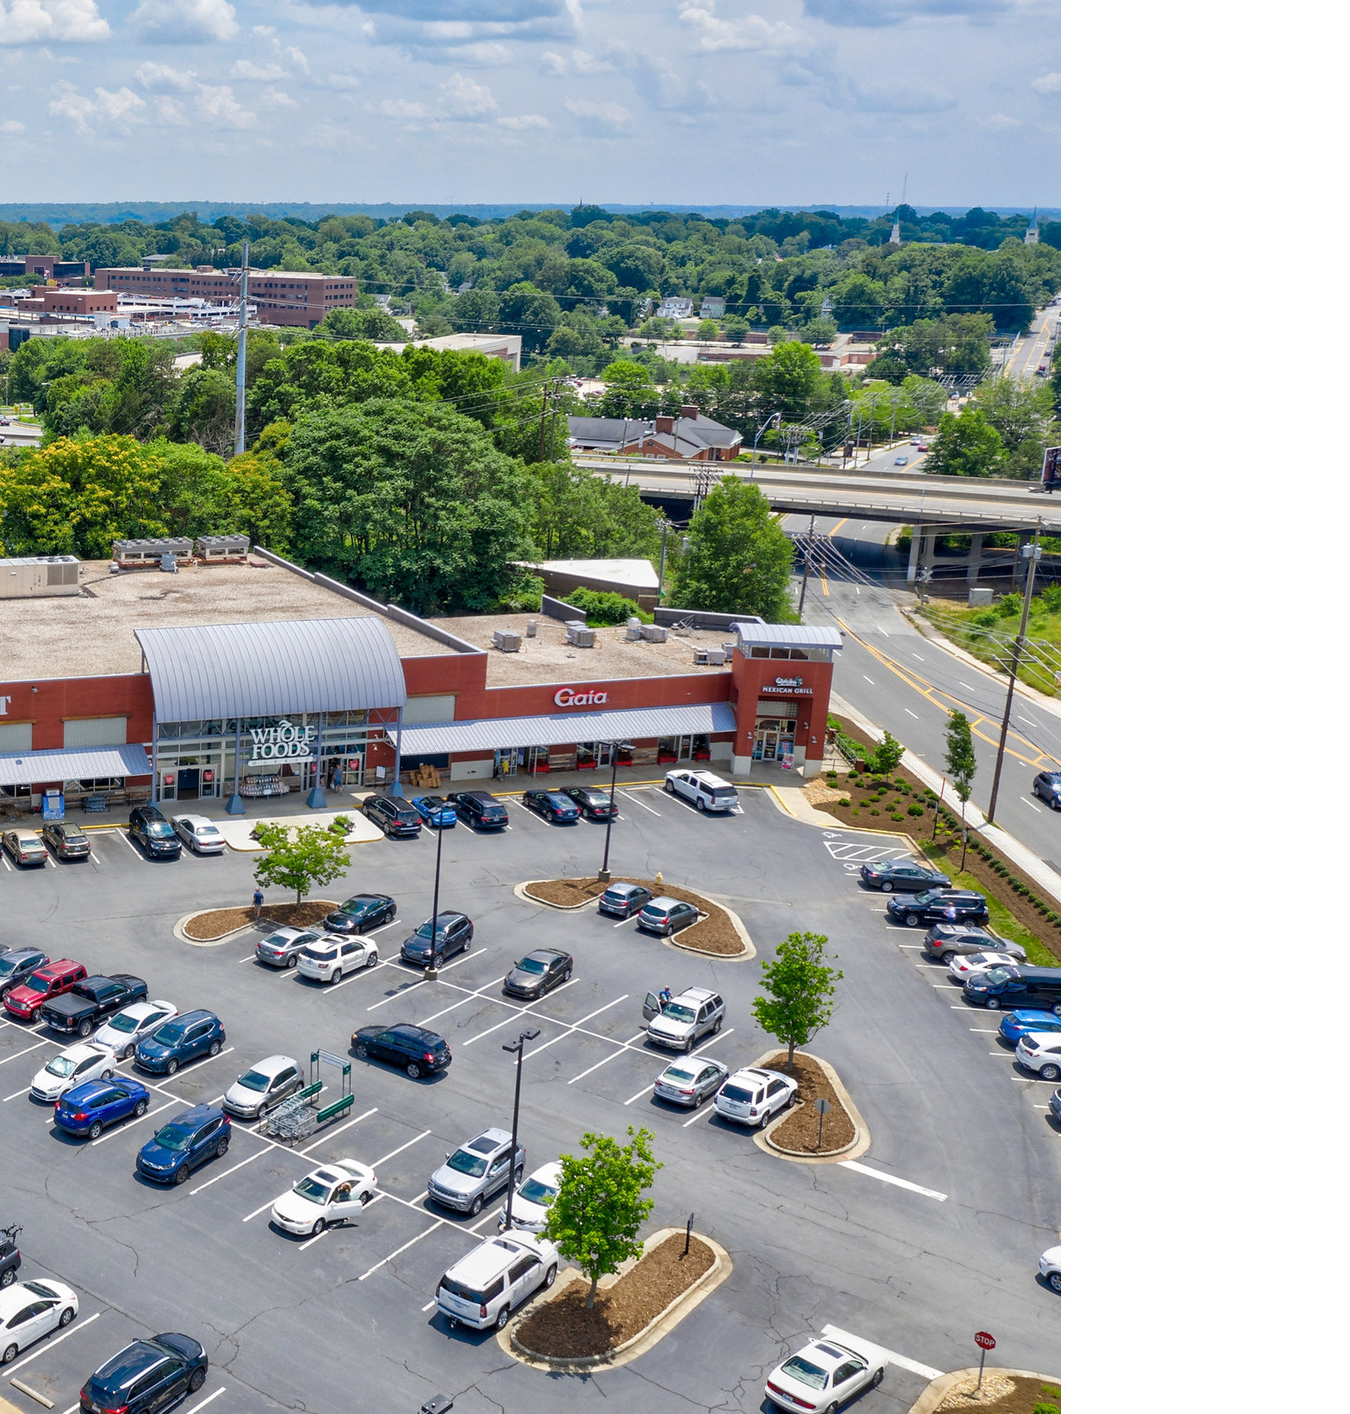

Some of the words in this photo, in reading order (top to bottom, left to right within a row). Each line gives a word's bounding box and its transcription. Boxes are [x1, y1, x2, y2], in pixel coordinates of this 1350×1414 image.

[554, 688, 607, 707] Gaia
[249, 720, 315, 744] WHOLE
[252, 740, 310, 760] FOODS
[975, 1334, 995, 1346] STOP
